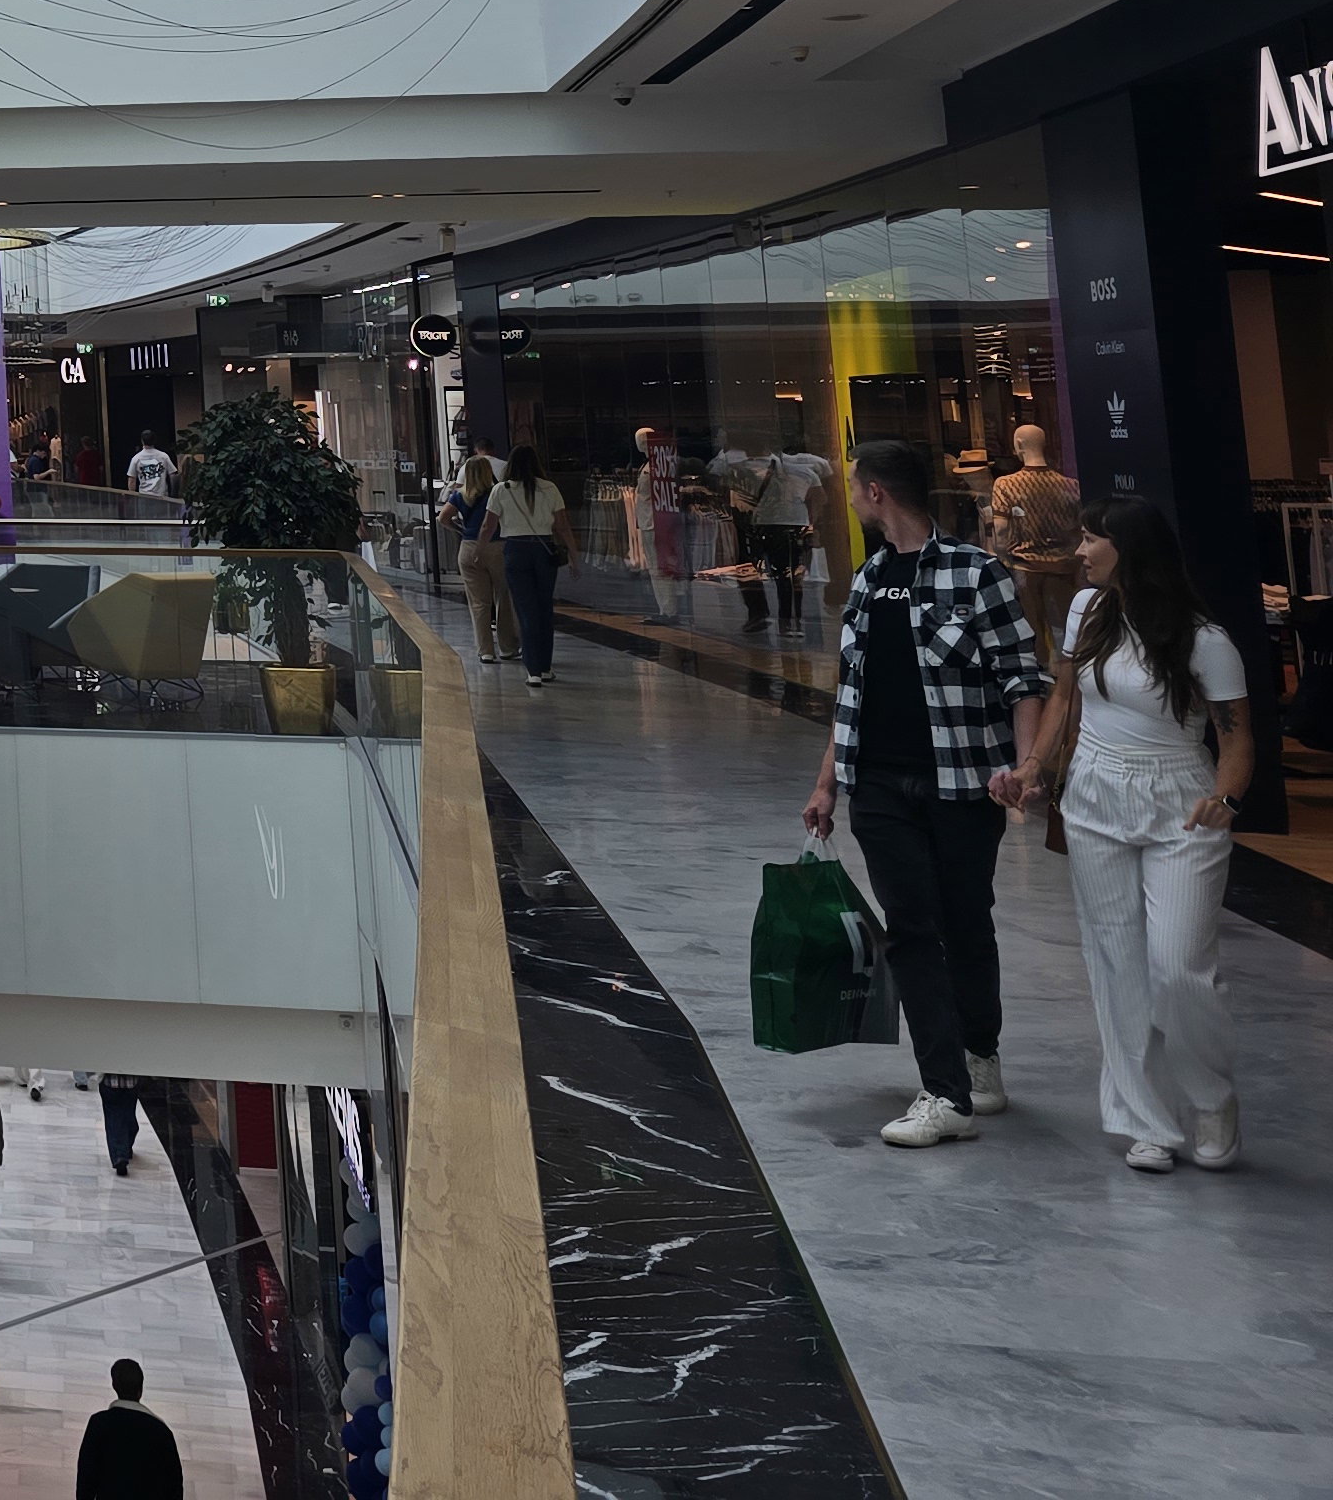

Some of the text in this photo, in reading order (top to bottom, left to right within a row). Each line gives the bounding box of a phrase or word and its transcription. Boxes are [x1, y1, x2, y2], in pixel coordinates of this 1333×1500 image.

[1090, 276, 1117, 302] BOSS
[60, 357, 87, 384] C&A
[1110, 425, 1129, 439] adidas
[1114, 473, 1135, 491] POLO
[653, 481, 680, 513] SALE
